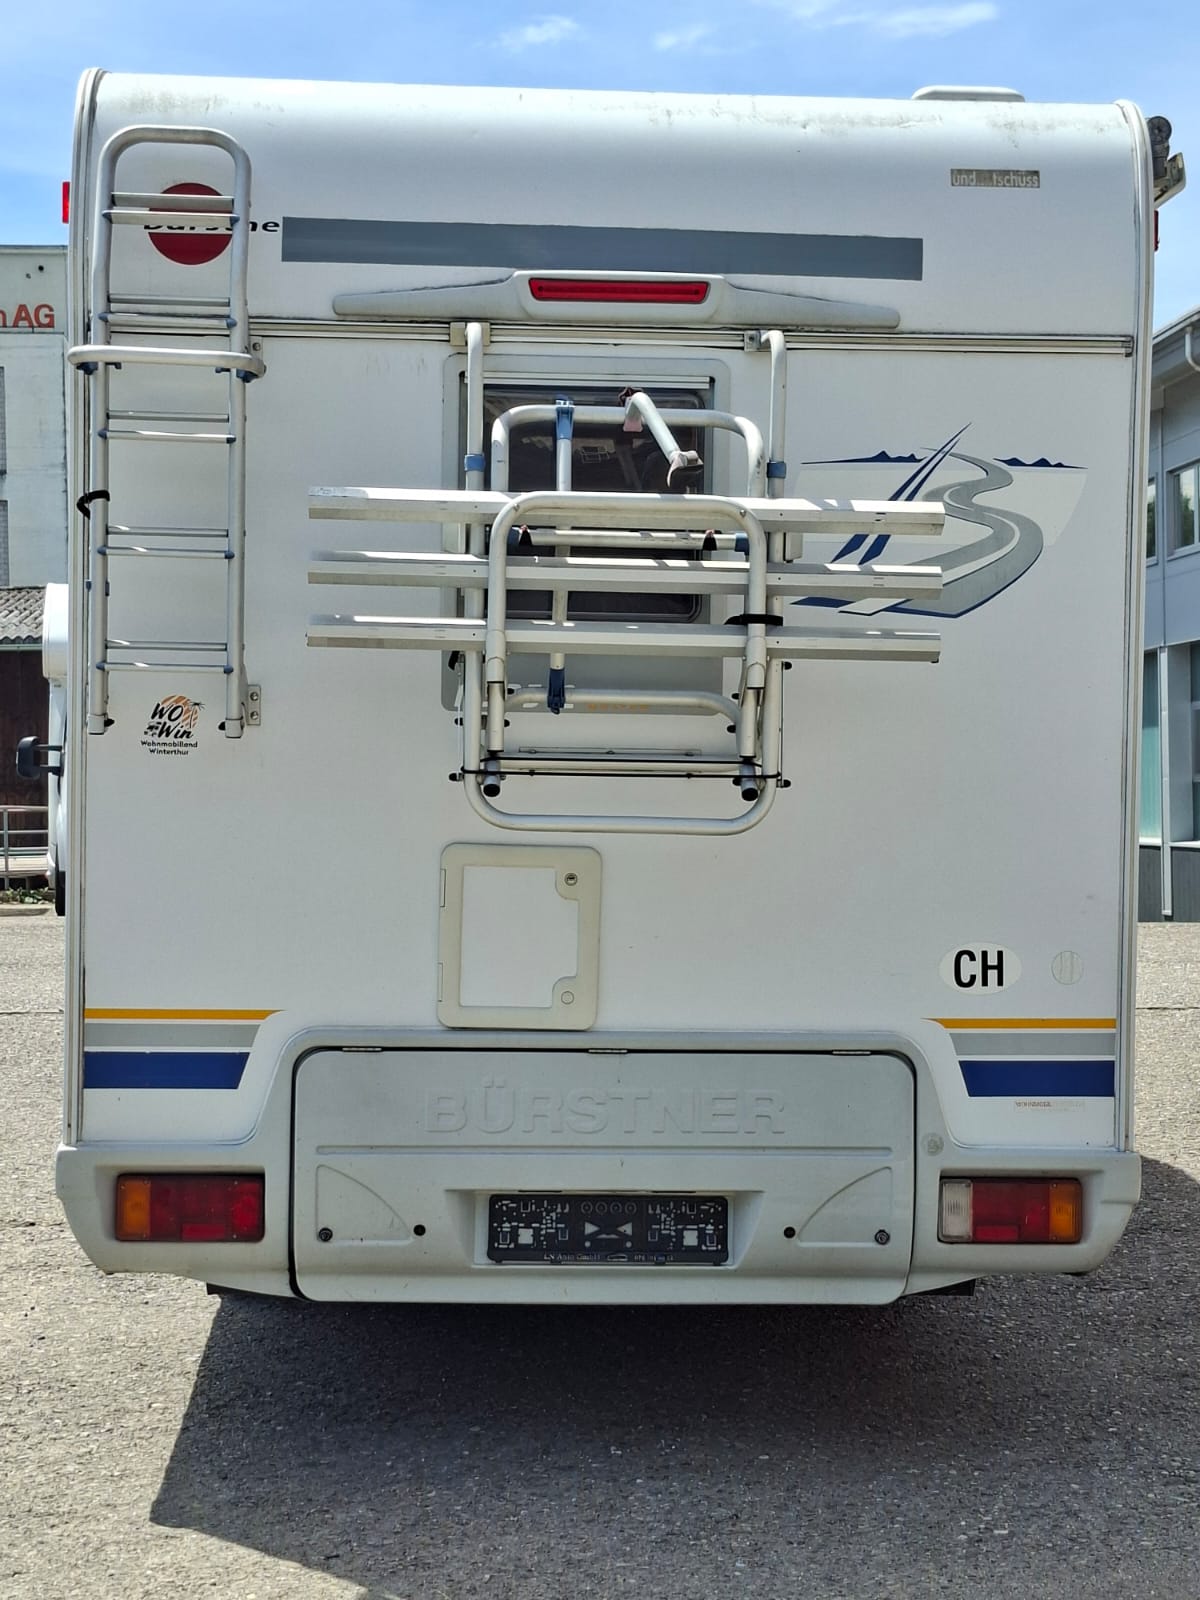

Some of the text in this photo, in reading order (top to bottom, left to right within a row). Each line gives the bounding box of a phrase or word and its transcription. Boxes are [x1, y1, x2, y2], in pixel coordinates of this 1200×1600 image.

[12, 303, 55, 328] AG
[150, 702, 184, 722] WO
[157, 721, 194, 739] Win
[148, 748, 190, 756] Winterthur
[953, 949, 1004, 988] CH
[424, 1074, 786, 1134] BÜRSTNER
